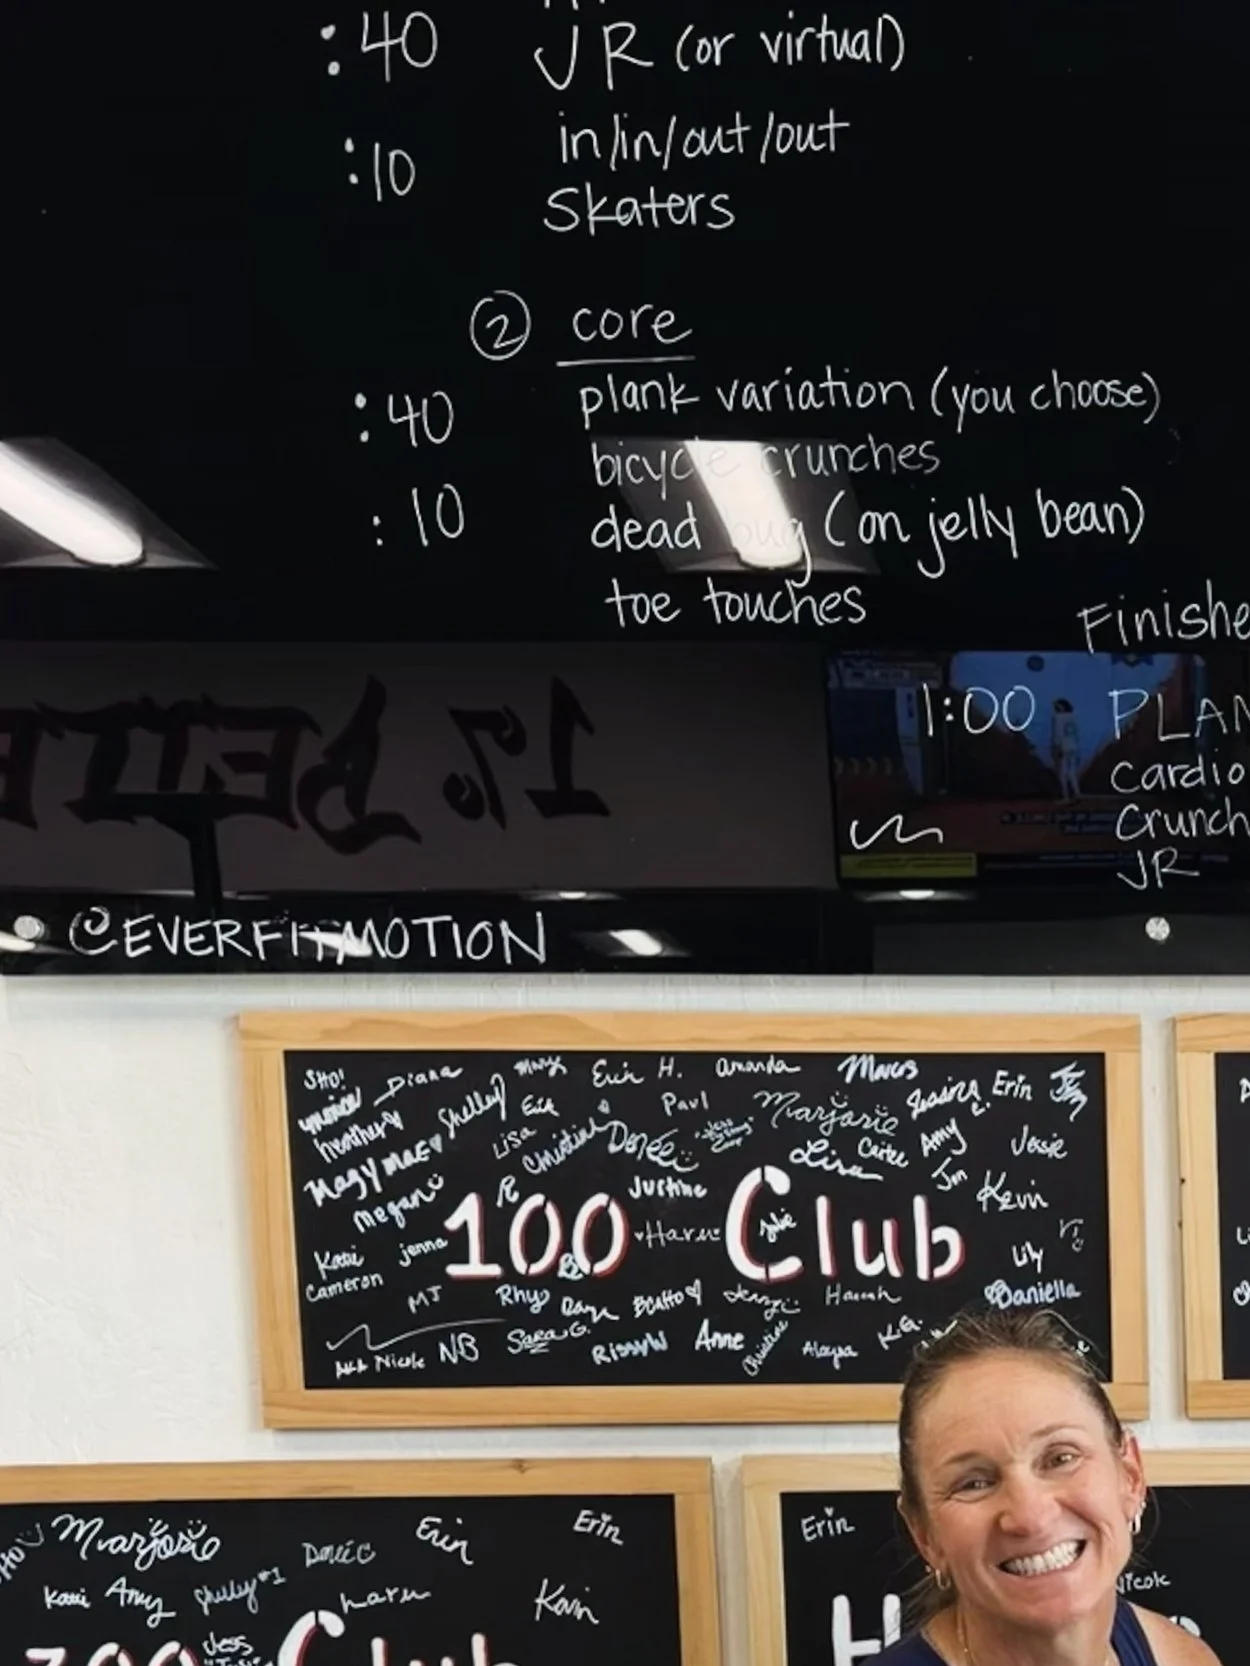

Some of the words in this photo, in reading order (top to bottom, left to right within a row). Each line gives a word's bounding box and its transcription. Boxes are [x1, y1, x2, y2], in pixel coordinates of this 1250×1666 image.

[320, 10, 438, 81] :40
[676, 24, 734, 71] (or
[758, 10, 904, 71] virtual)
[343, 137, 415, 201] :10
[543, 182, 735, 236] Skaters
[572, 303, 692, 345] core
[354, 391, 454, 447] :40
[579, 372, 699, 430] plank
[716, 366, 914, 413] variation
[931, 366, 1014, 433] (you
[1030, 369, 1161, 424] choose)
[761, 432, 940, 476] crunches
[372, 484, 464, 546] :10
[590, 502, 701, 551] dead
[825, 491, 909, 546] (on
[918, 495, 1018, 577] jelly
[1037, 486, 1144, 544] bean)
[605, 578, 681, 627] toe
[703, 577, 865, 626] touches
[923, 683, 1036, 736] 1:00
[1117, 847, 1200, 889] JR
[661, 1090, 709, 1116] Paul
[992, 1070, 1033, 1101] Erin
[920, 1117, 967, 1157] Amy
[444, 1192, 630, 1280] 100
[725, 1164, 966, 1284] Club
[306, 1273, 384, 1302] Cameron
[573, 1509, 624, 1546] Erin
[801, 1506, 856, 1543] Erin
